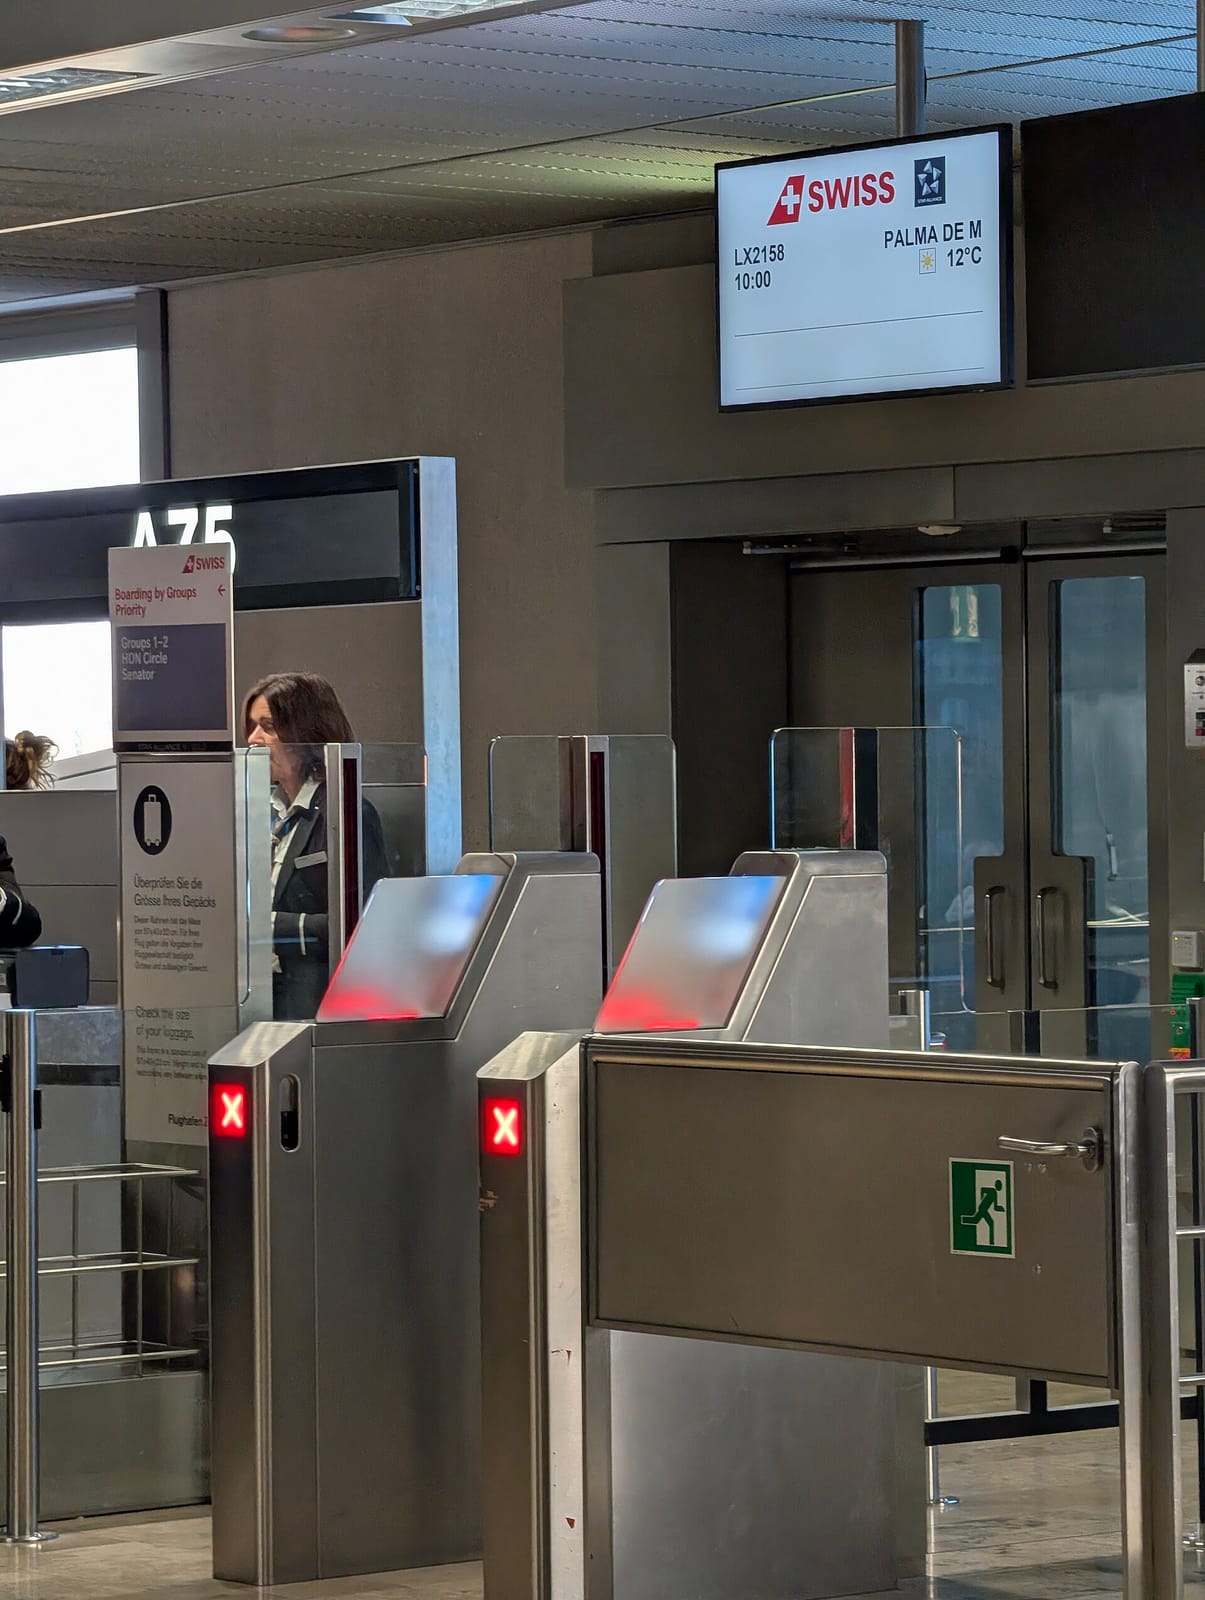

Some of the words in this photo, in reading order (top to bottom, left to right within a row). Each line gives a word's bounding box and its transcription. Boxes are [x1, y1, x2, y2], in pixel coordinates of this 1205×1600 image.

[807, 171, 895, 213] SWISS
[884, 225, 938, 249] PALMA
[943, 222, 965, 241] DE
[969, 220, 982, 239] M
[734, 243, 785, 266] LX2158
[946, 246, 982, 267] 12°C
[734, 270, 772, 291] 10:00
[195, 556, 225, 570] SWISS
[115, 587, 152, 602] Boarding
[154, 586, 165, 601] by
[167, 586, 197, 602] Groups
[115, 604, 146, 618] Priority
[121, 636, 151, 650] Groups
[122, 652, 141, 665] HON
[143, 651, 168, 665] Circle
[122, 668, 155, 681] Senator
[134, 873, 175, 891] Überprüfen
[177, 876, 189, 889] Sie
[191, 877, 203, 889] die
[134, 893, 161, 906] Grösse
